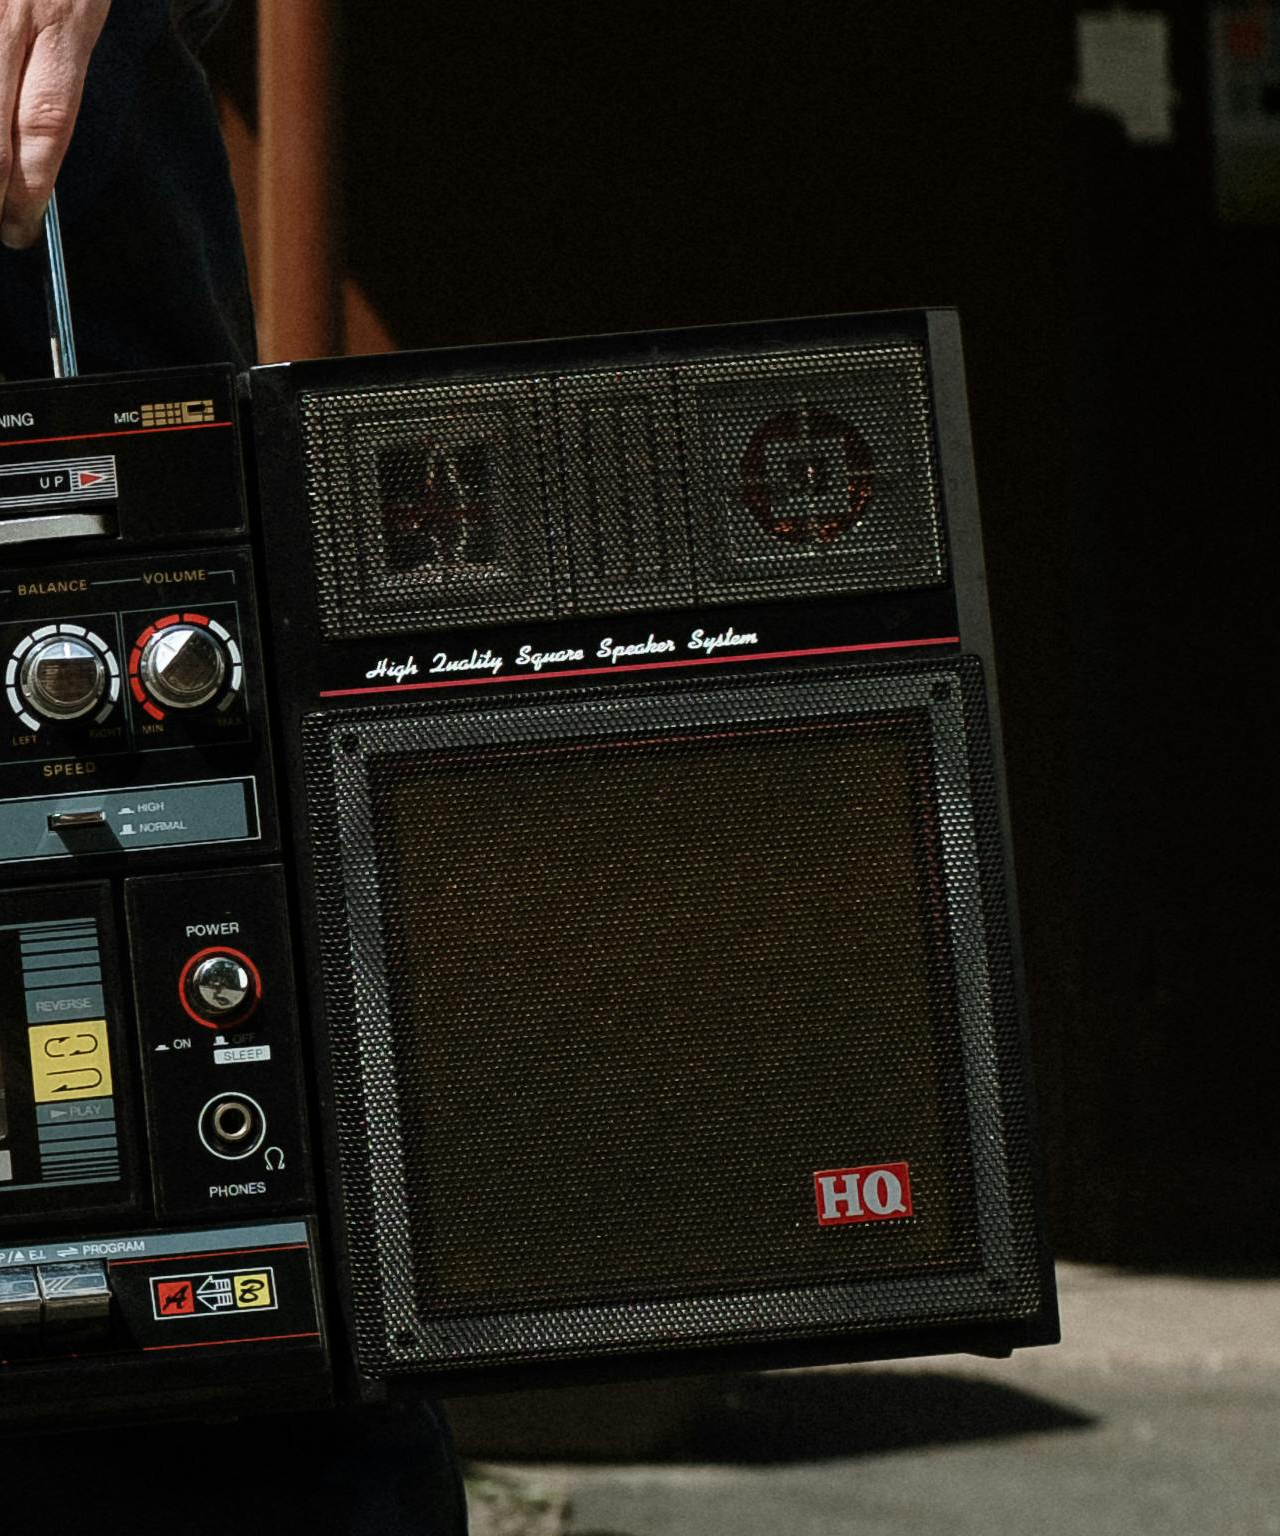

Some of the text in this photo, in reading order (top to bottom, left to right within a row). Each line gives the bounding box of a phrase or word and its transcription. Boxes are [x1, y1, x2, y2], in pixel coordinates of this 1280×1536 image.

[114, 411, 139, 424] MIC
[143, 569, 207, 585] VOLUME
[18, 580, 87, 596] BALANCE
[366, 626, 757, 679] High Quality Square Speaker System
[142, 724, 164, 734] MIN
[12, 734, 37, 746] LEFT
[43, 762, 96, 777] SPEED
[137, 801, 165, 813] HIGH
[139, 820, 187, 833] NORMAL
[185, 922, 240, 937] POWER
[35, 996, 92, 1013] REVERSE
[173, 1038, 191, 1050] ON
[224, 1048, 263, 1062] SLEEP
[69, 1104, 102, 1118] PLAY
[209, 1182, 267, 1198] PHONES
[818, 1169, 907, 1219] HQ
[82, 1240, 145, 1255] PROGRAM
